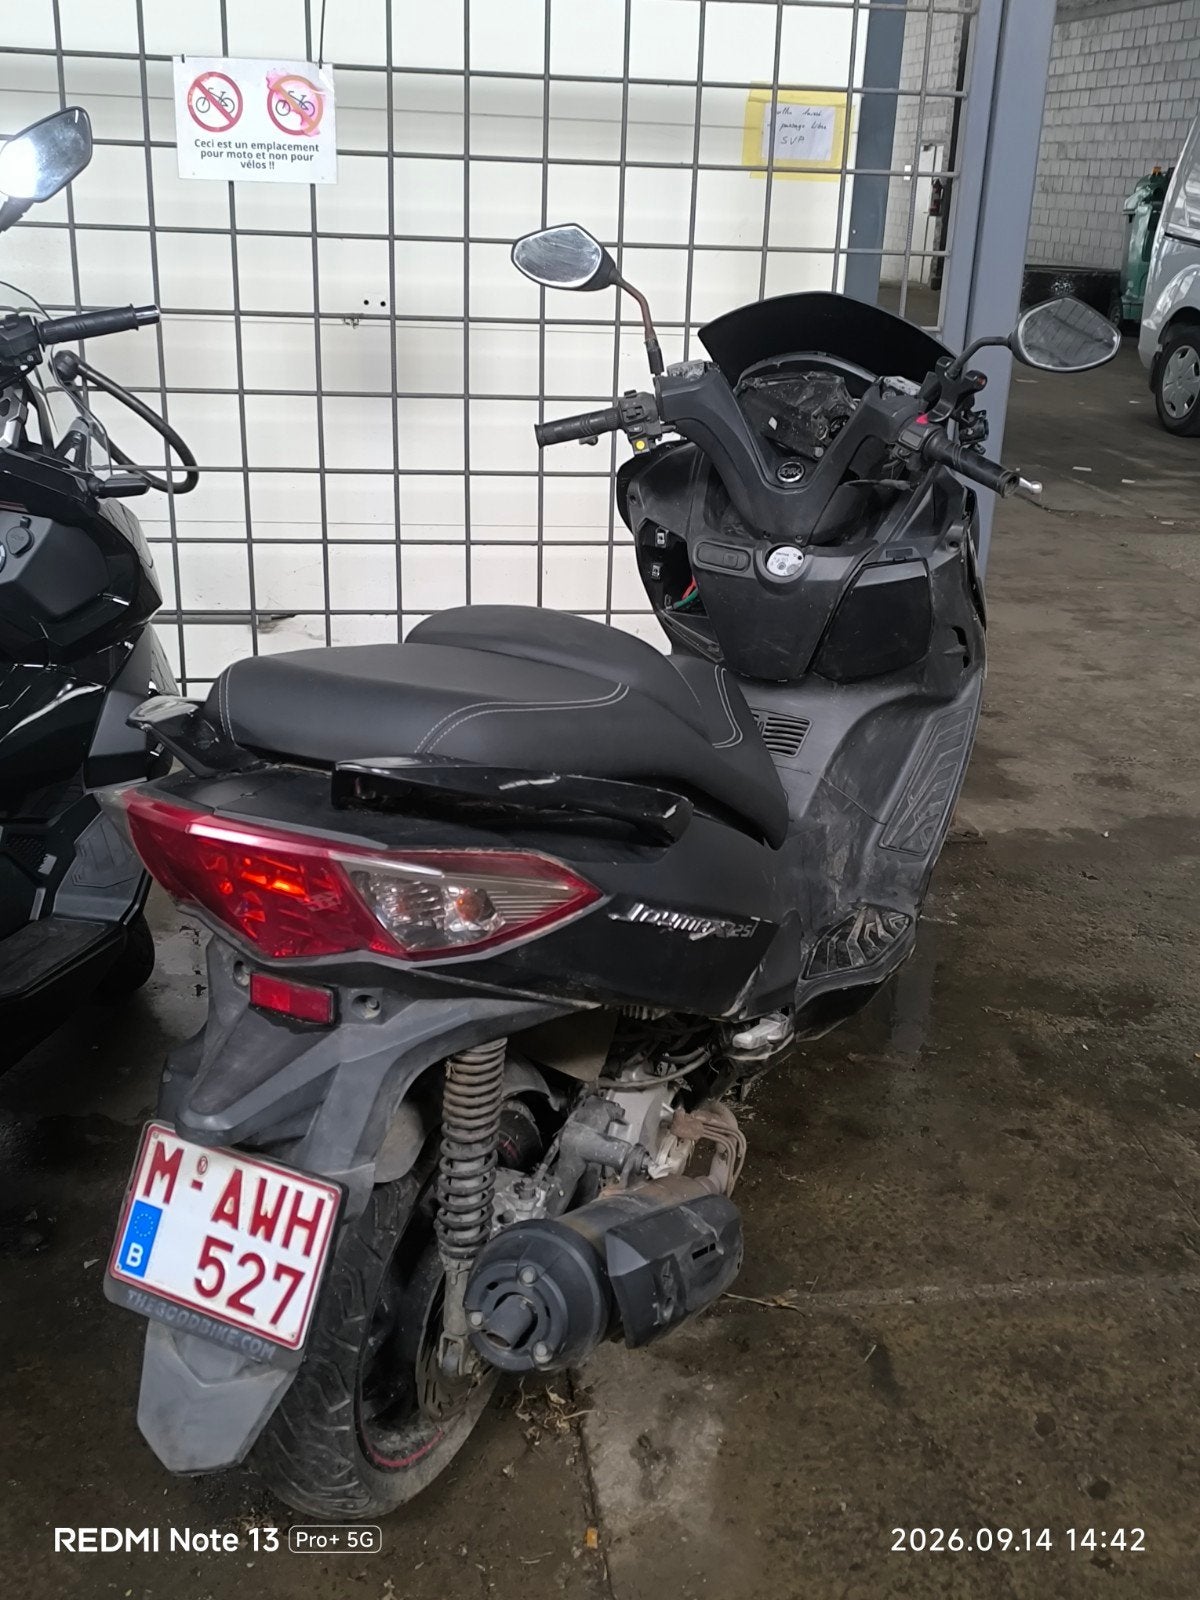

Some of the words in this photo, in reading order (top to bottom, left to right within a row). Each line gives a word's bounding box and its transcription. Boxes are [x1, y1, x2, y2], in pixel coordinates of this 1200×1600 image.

[194, 139, 214, 148] Ceci
[250, 142, 319, 152] emplacement
[780, 136, 805, 145] SVP
[200, 150, 223, 160] pour
[226, 151, 253, 159] moto
[255, 152, 266, 160] et
[269, 153, 288, 161] non
[290, 154, 314, 163] pour
[240, 160, 267, 169] vélos
[126, 1243, 144, 1267] B
[194, 1235, 305, 1325] 527
